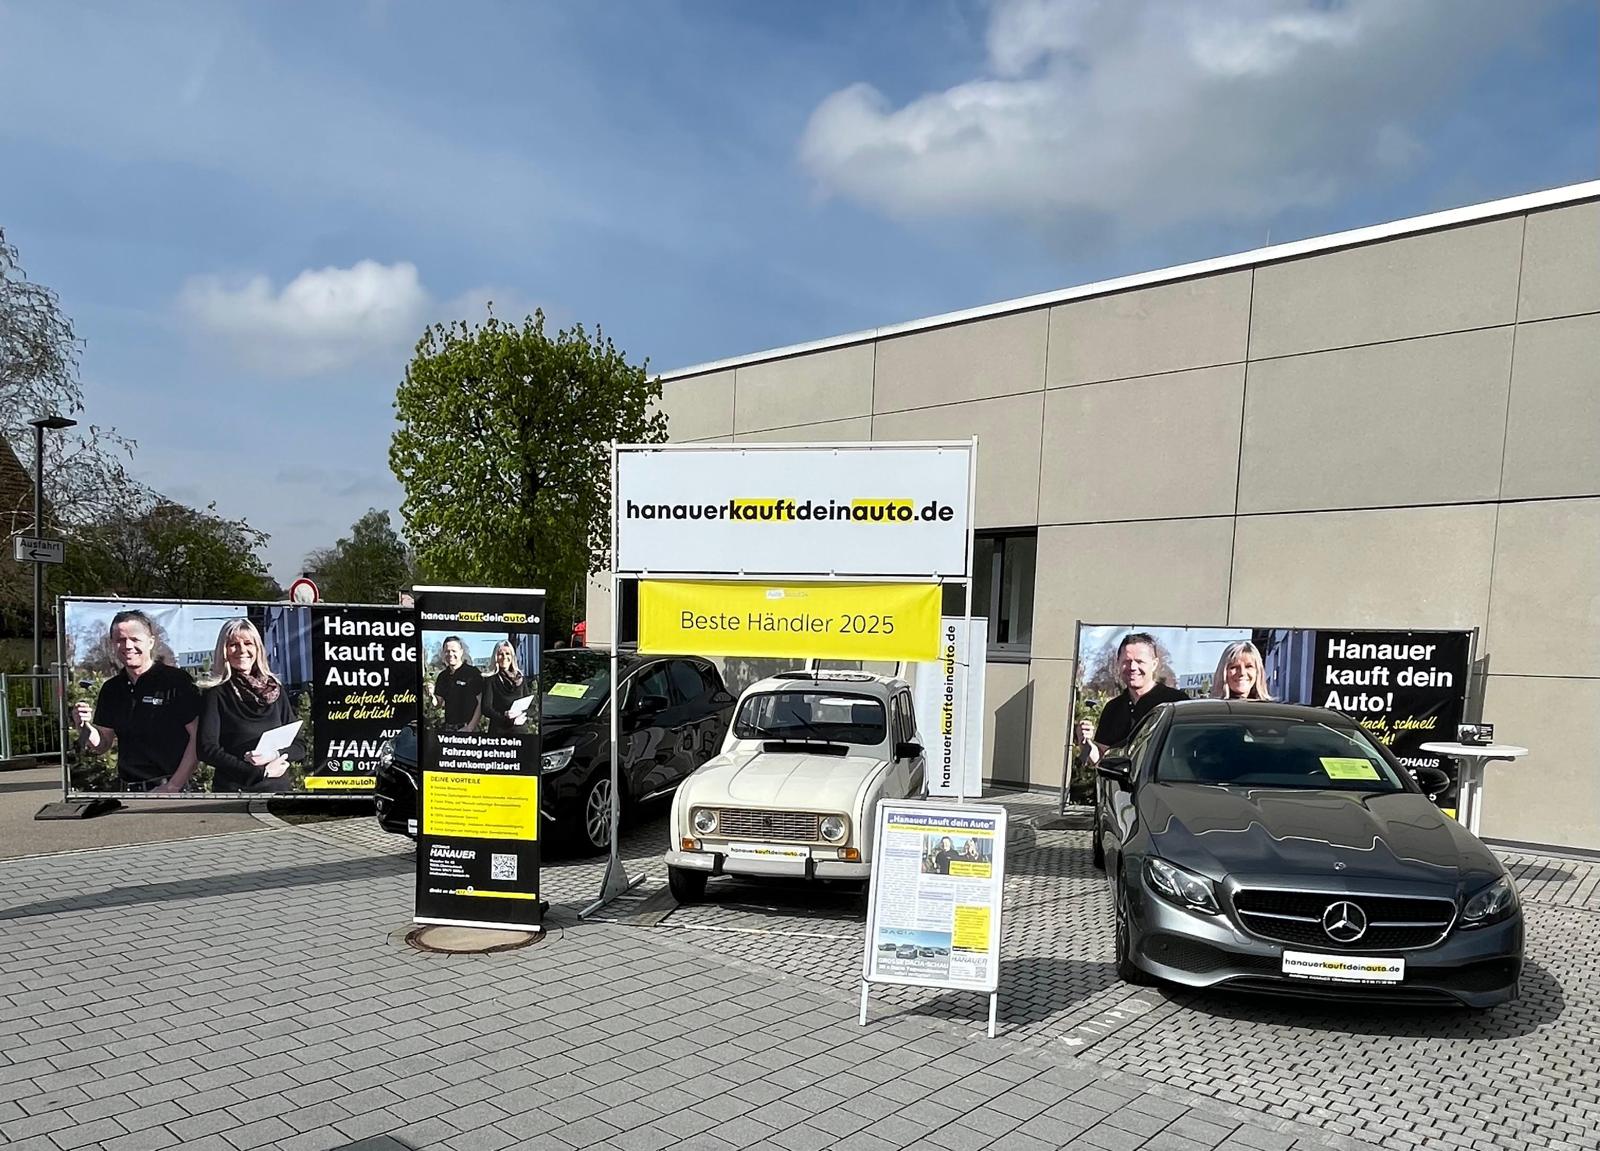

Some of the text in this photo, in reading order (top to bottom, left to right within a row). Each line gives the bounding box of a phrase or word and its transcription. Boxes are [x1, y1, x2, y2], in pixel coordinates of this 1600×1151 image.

[626, 500, 954, 522] hanauerkauftdeinauto.de
[20, 539, 60, 550] Ausfahrt
[420, 611, 540, 624] hanauerkauftdeinauto.de
[681, 611, 894, 634] Beste Händler 2025
[324, 616, 415, 636] Hanaue
[325, 642, 416, 661] kauft de
[1328, 639, 1436, 660] Hanauer
[325, 667, 390, 687] Auto!
[1325, 665, 1453, 687] kauft dein
[345, 690, 388, 706] einfach,
[1324, 690, 1394, 712] Auto!
[328, 705, 395, 720] und ehrlich!
[940, 625, 956, 788] hanauerkauftdeinauto.de
[1393, 715, 1438, 730] schnell
[438, 735, 522, 747] Verkaufe jetzt Dein
[442, 747, 517, 759] Fahrzeug schnell
[439, 760, 521, 771] und unkompliziert!
[1398, 758, 1440, 768] OHAUS
[928, 817, 950, 826] kauft
[950, 818, 969, 828] dein
[430, 848, 476, 860] HANAUER
[1285, 958, 1400, 972] hanauerkauftdeinauto.de
